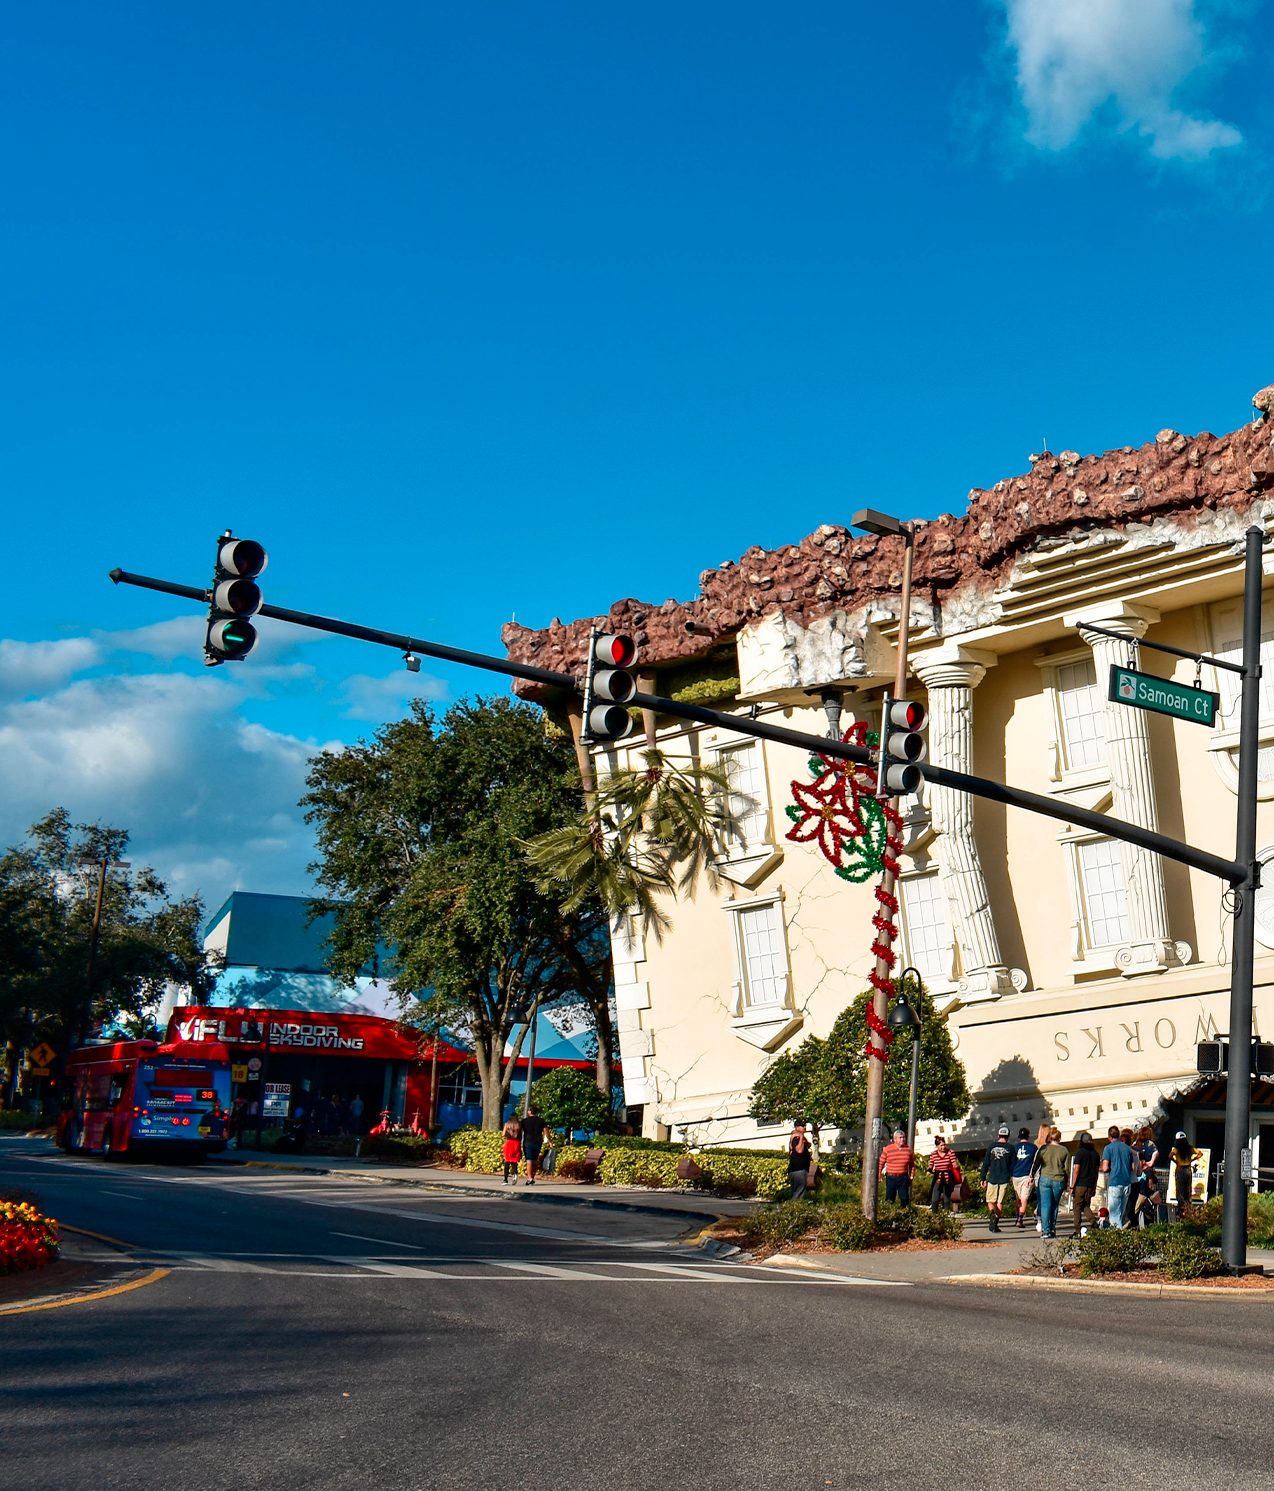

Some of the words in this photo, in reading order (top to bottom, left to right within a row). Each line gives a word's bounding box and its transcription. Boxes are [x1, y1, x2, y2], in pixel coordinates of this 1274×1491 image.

[1138, 683, 1189, 711] Samoan
[1194, 697, 1209, 717] Ct
[270, 1022, 339, 1038] INDOOR
[269, 1033, 364, 1050] SKYDIVING
[201, 1091, 214, 1099] 38
[275, 1084, 290, 1094] LEASE
